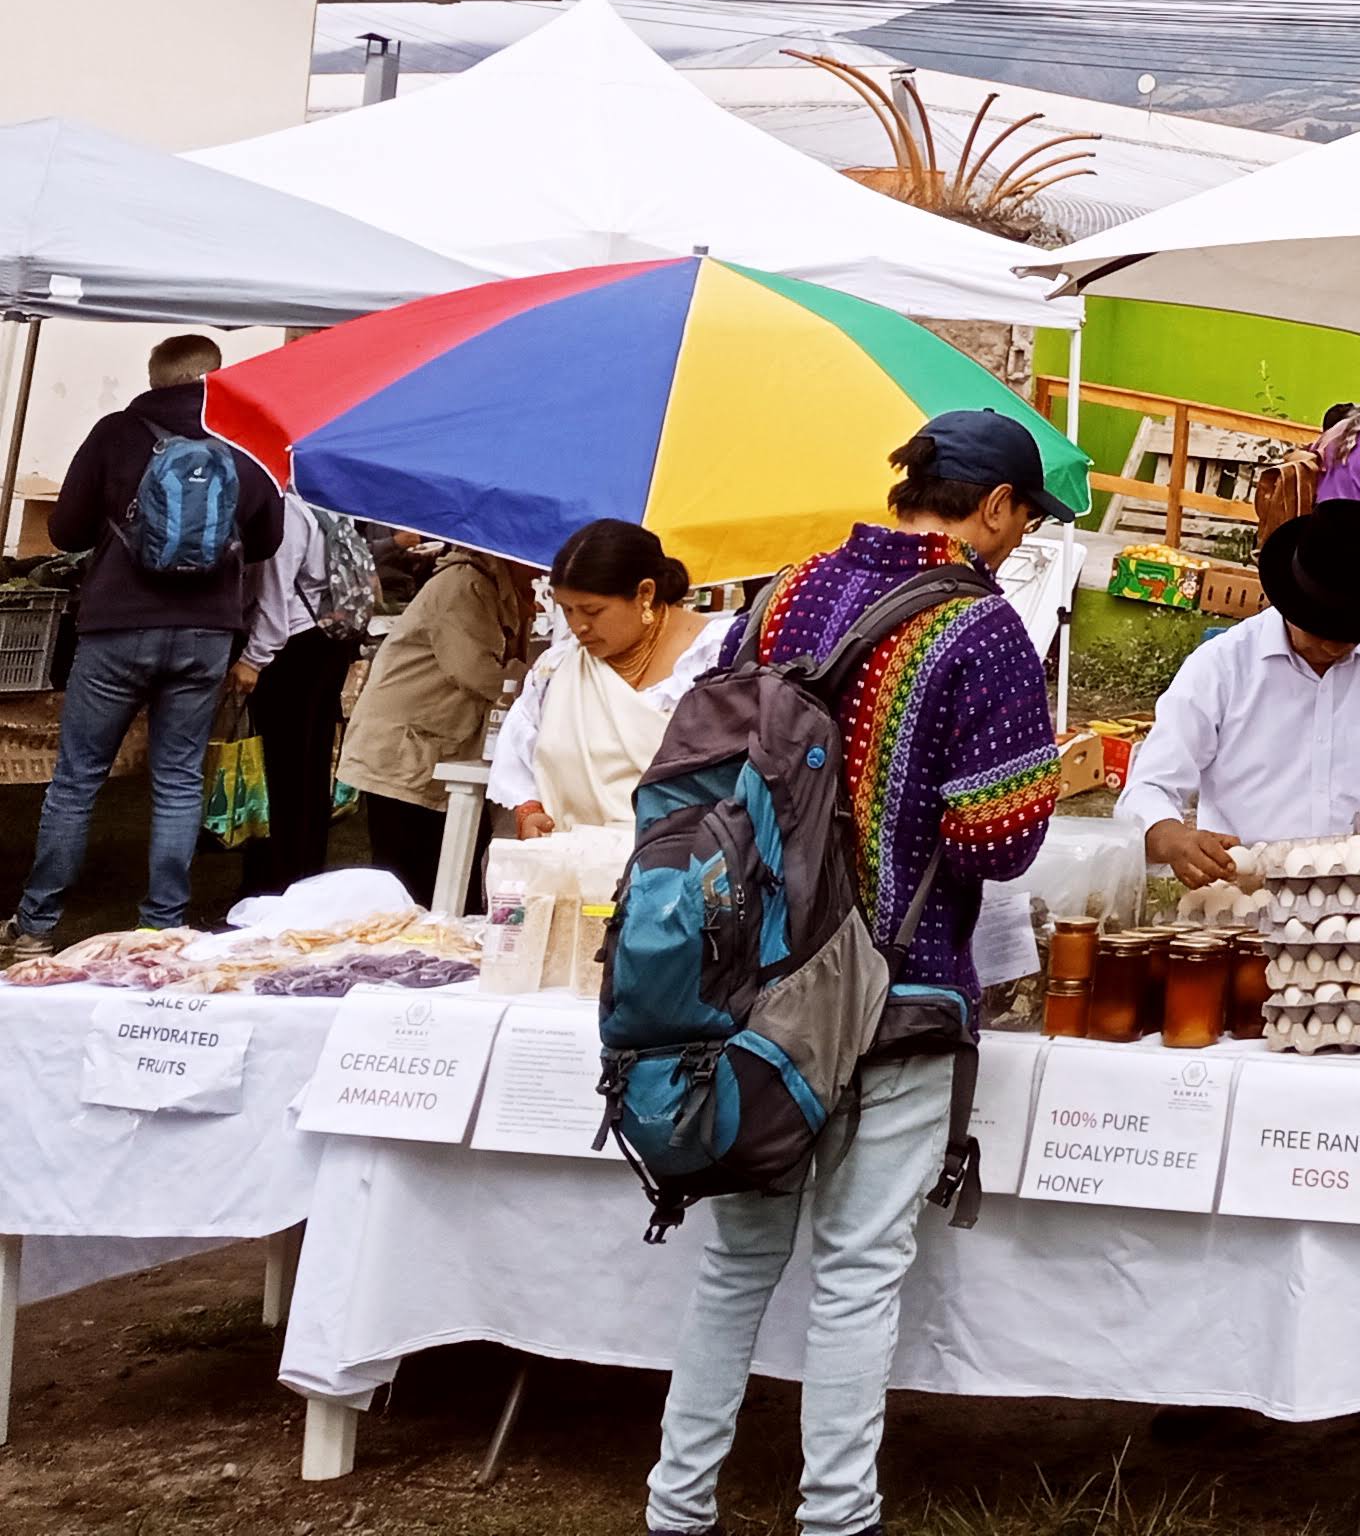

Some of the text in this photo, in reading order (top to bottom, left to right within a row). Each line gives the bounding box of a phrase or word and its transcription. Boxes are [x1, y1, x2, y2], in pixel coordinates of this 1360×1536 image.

[146, 997, 210, 1012] SALE OF
[118, 1023, 219, 1048] DEHYDRATED
[136, 1056, 186, 1076] FRUITS
[340, 1052, 459, 1077] CEREALES DE
[337, 1086, 438, 1110] AMARANTO
[1050, 1110, 1150, 1133] 100% PURE
[1260, 1129, 1312, 1150] FREE
[1043, 1141, 1198, 1170] EUCALYPTUS BEE
[1037, 1174, 1104, 1195] HONEY
[1291, 1167, 1350, 1190] EGGS
